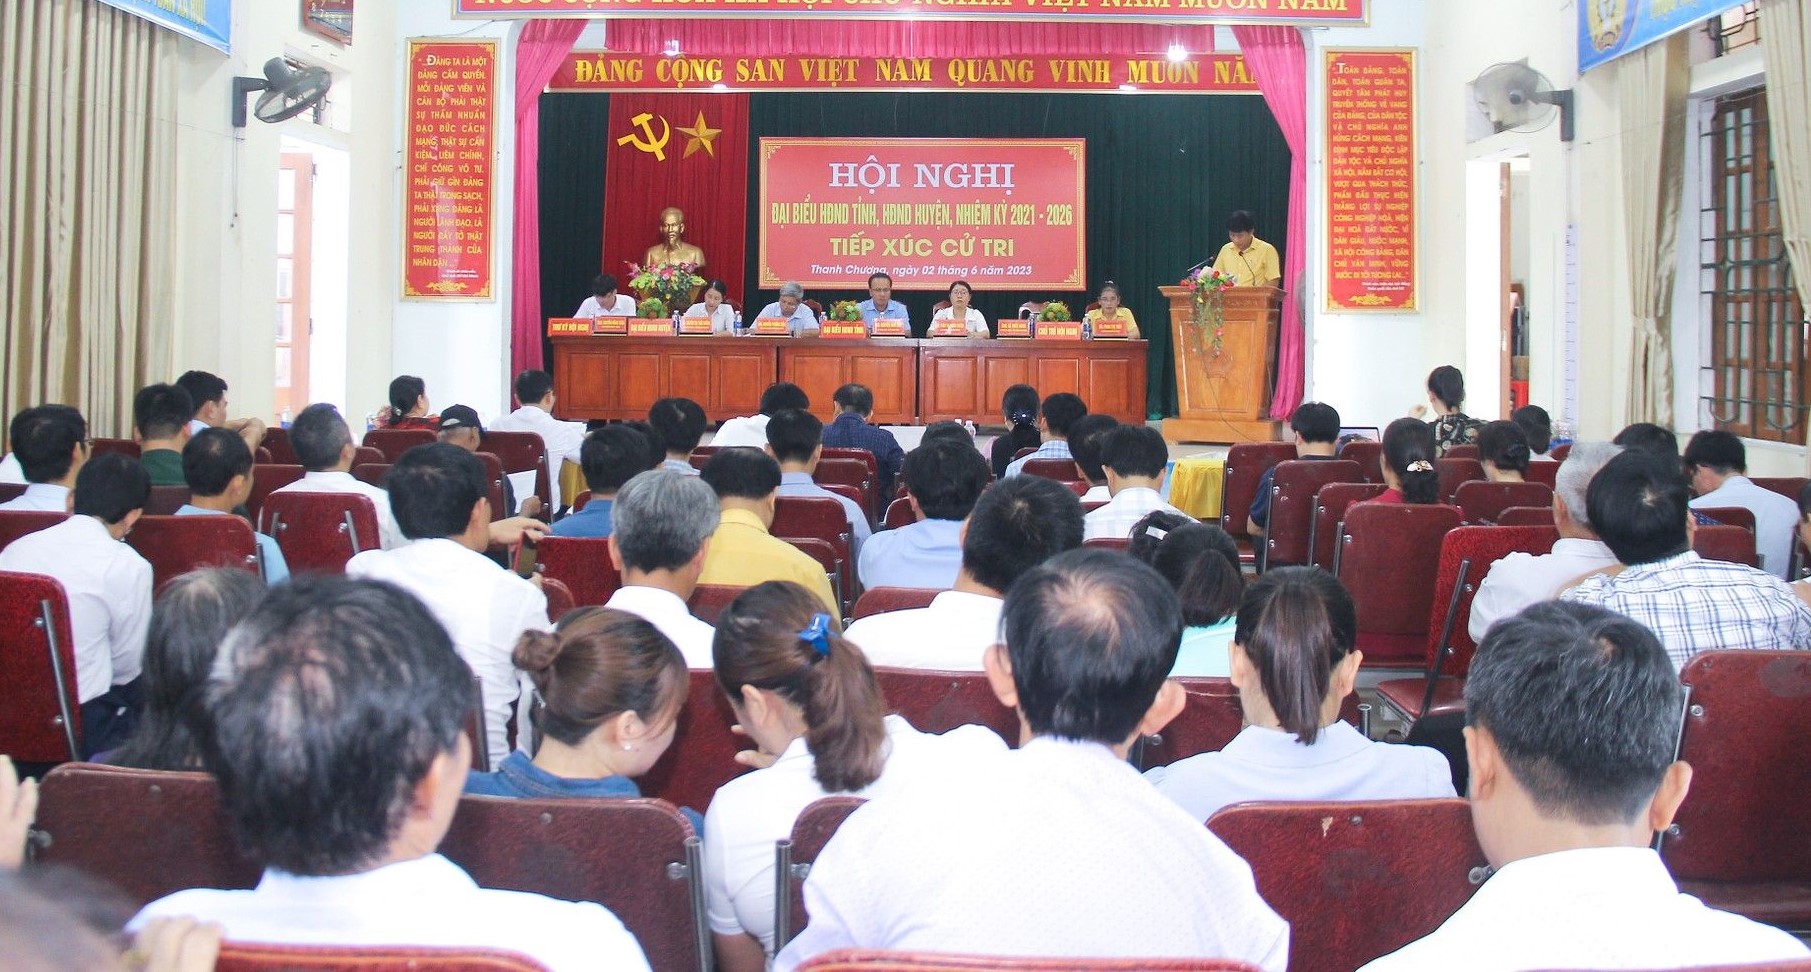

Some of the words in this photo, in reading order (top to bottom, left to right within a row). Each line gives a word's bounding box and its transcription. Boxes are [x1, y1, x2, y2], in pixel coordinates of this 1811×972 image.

[575, 53, 643, 82] ĐẢNG
[875, 59, 932, 82] NAM
[948, 59, 1035, 87] QUANG
[1048, 59, 1111, 83] VINH
[1213, 57, 1257, 84] NĂ
[828, 154, 900, 195] HỘI
[914, 163, 1015, 196] NGHỊ
[772, 202, 789, 229] ĐẠI
[793, 194, 817, 225] BIỂU
[819, 203, 849, 225] HĐND
[852, 196, 879, 227] TỈNH,
[882, 203, 911, 225] HĐND
[915, 202, 953, 230] HUYỆN,
[956, 199, 991, 230] NHIỆM
[994, 199, 1008, 225] KỲ
[1010, 203, 1035, 225] 2021
[1046, 203, 1072, 225] 2026
[830, 231, 875, 256] TIẾP
[881, 231, 933, 256] XÚC
[940, 232, 975, 256] CỬ
[982, 239, 1014, 256] TRI
[811, 264, 842, 275] Thanh
[892, 266, 920, 277] ngày
[922, 265, 934, 275] 02
[937, 264, 968, 277] tháng
[971, 265, 978, 275] 6
[980, 264, 1005, 275] năm
[1007, 265, 1032, 275] 2023
